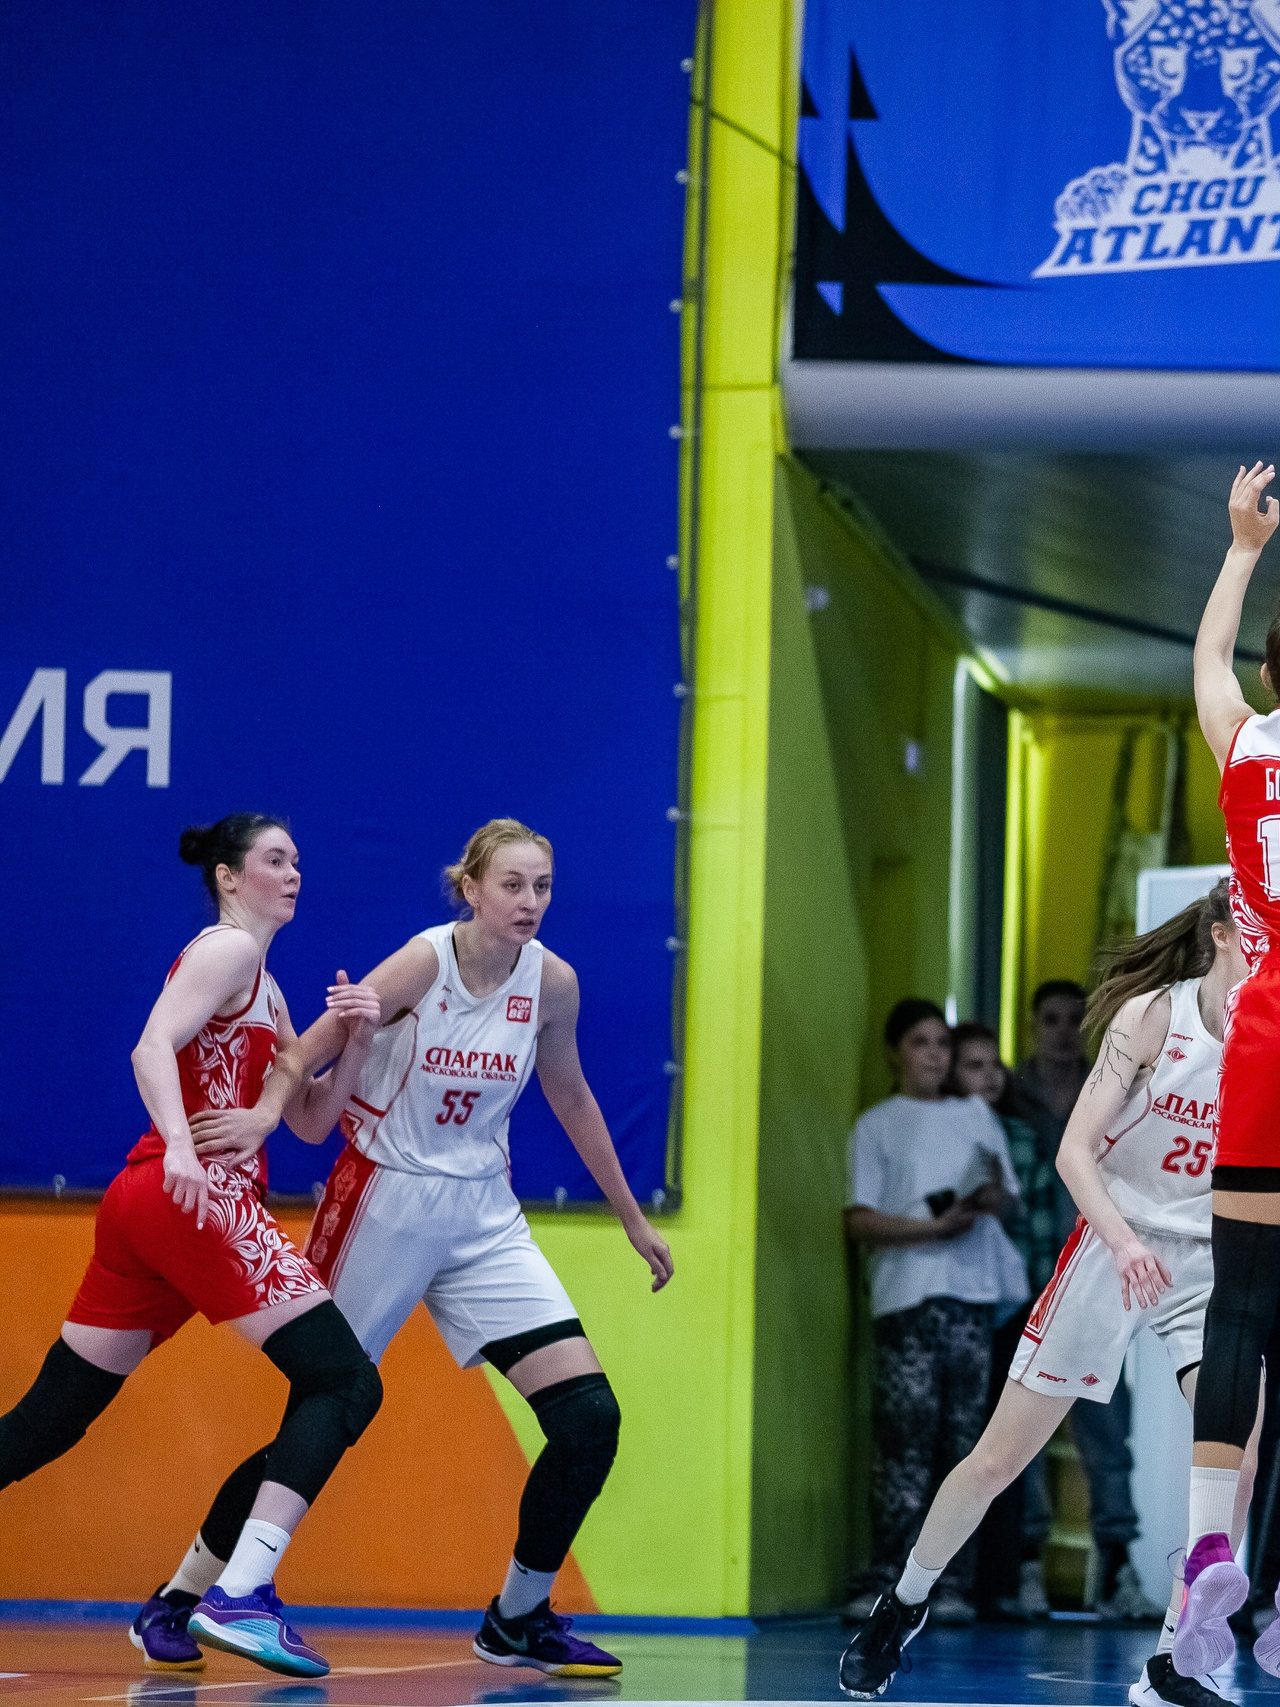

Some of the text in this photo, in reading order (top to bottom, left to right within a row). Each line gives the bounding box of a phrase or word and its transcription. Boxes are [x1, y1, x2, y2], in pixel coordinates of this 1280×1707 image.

[1132, 175, 1266, 217] CHGU
[420, 1063, 517, 1082] МОСКОВСКАЯ ОБЛАСТЬ
[425, 1047, 517, 1073] СПАРТАК
[435, 1090, 482, 1125] 55
[1153, 1093, 1214, 1121] СПАР
[1161, 1136, 1212, 1177] 25
